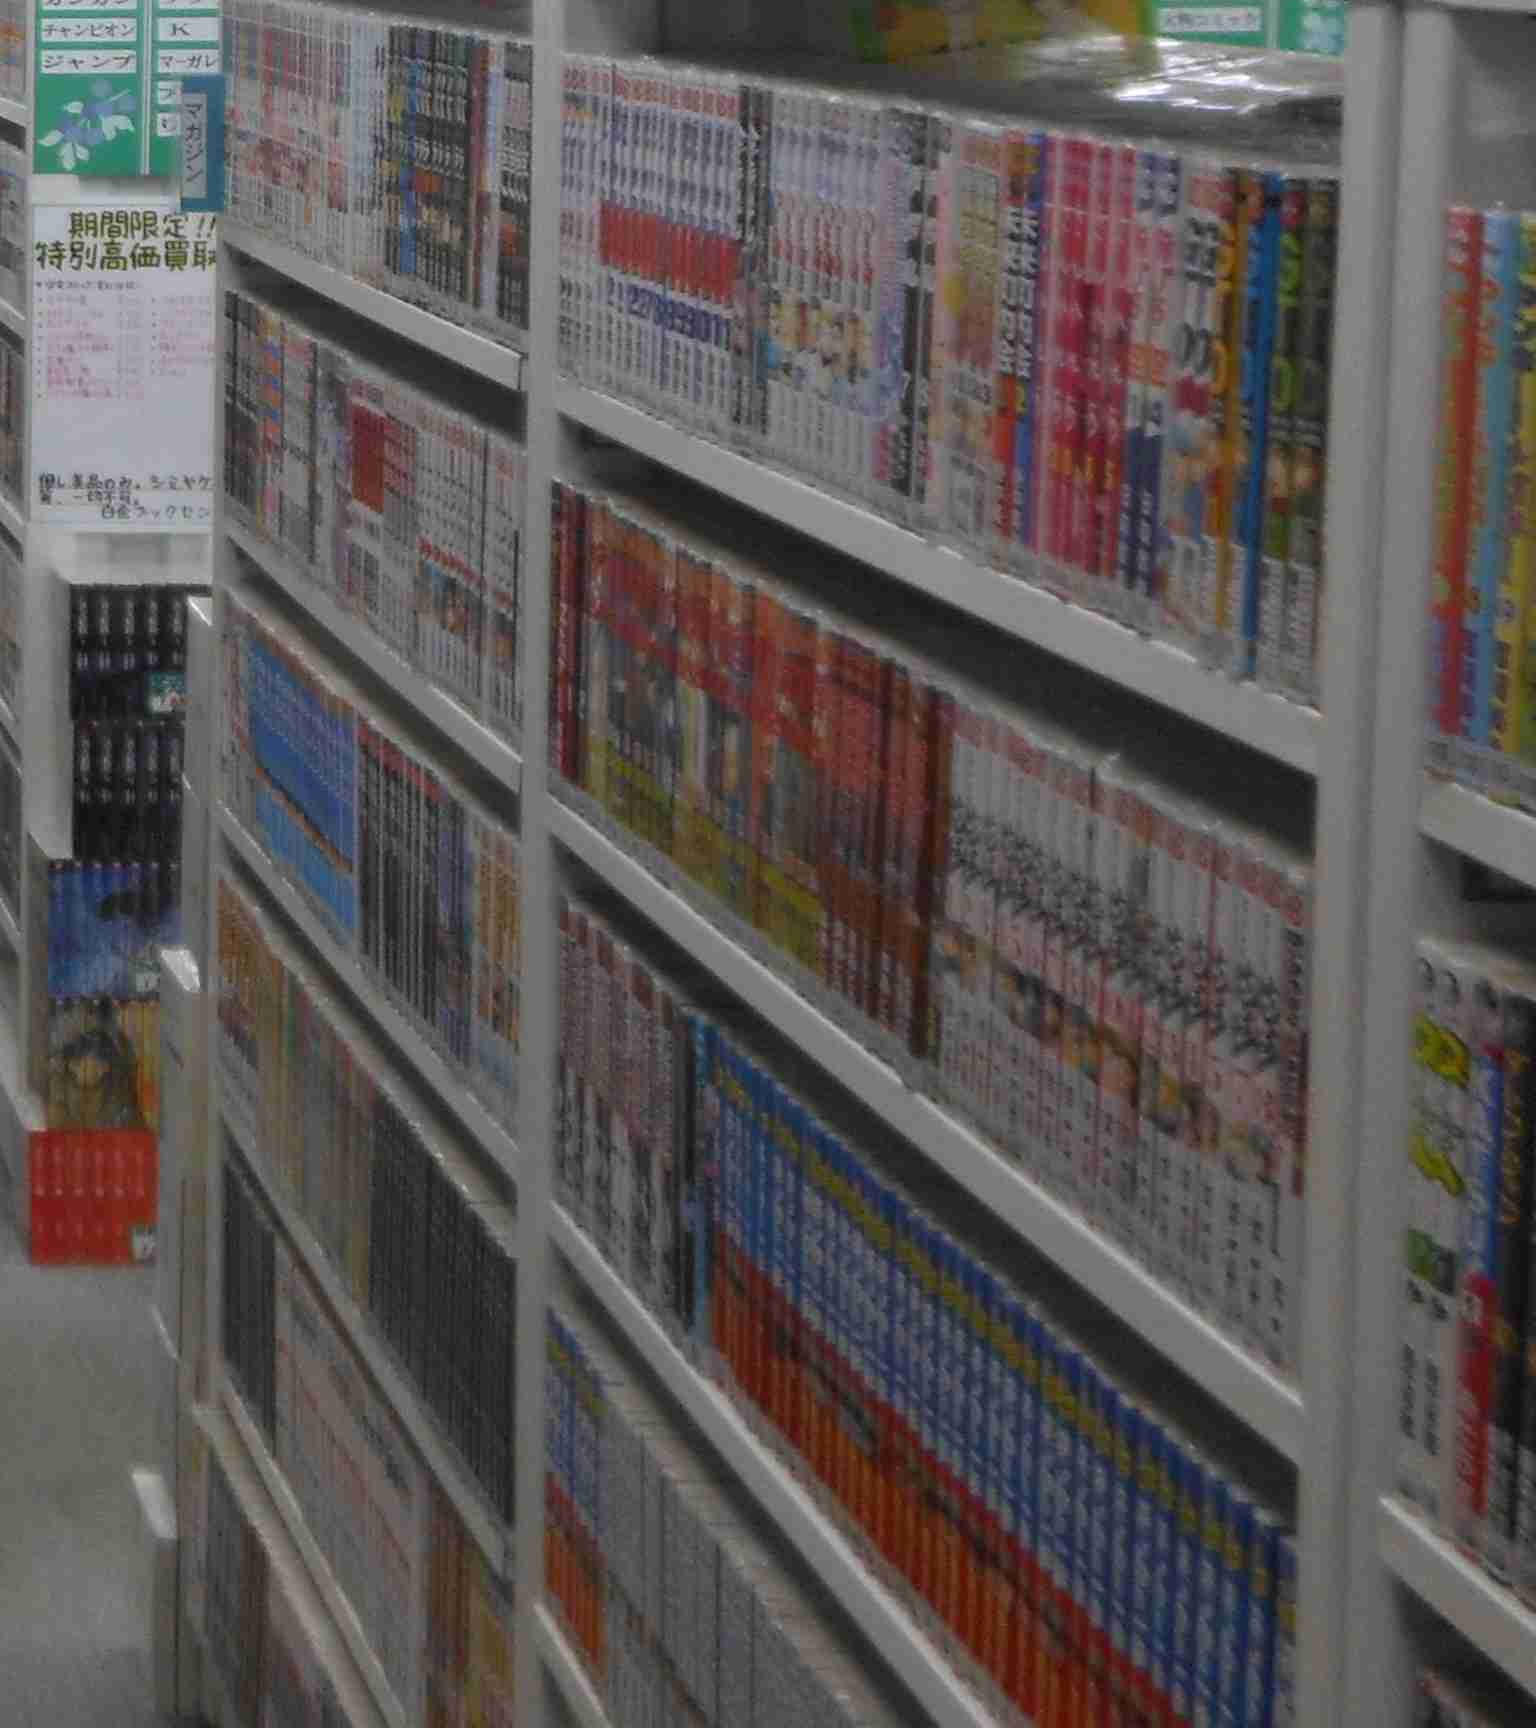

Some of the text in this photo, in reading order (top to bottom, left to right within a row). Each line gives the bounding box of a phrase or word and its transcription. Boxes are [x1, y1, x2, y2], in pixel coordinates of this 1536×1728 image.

[45, 22, 134, 37] チャンピオン
[69, 210, 217, 240] 期間限定!!
[33, 239, 217, 272] 特別高価買取
